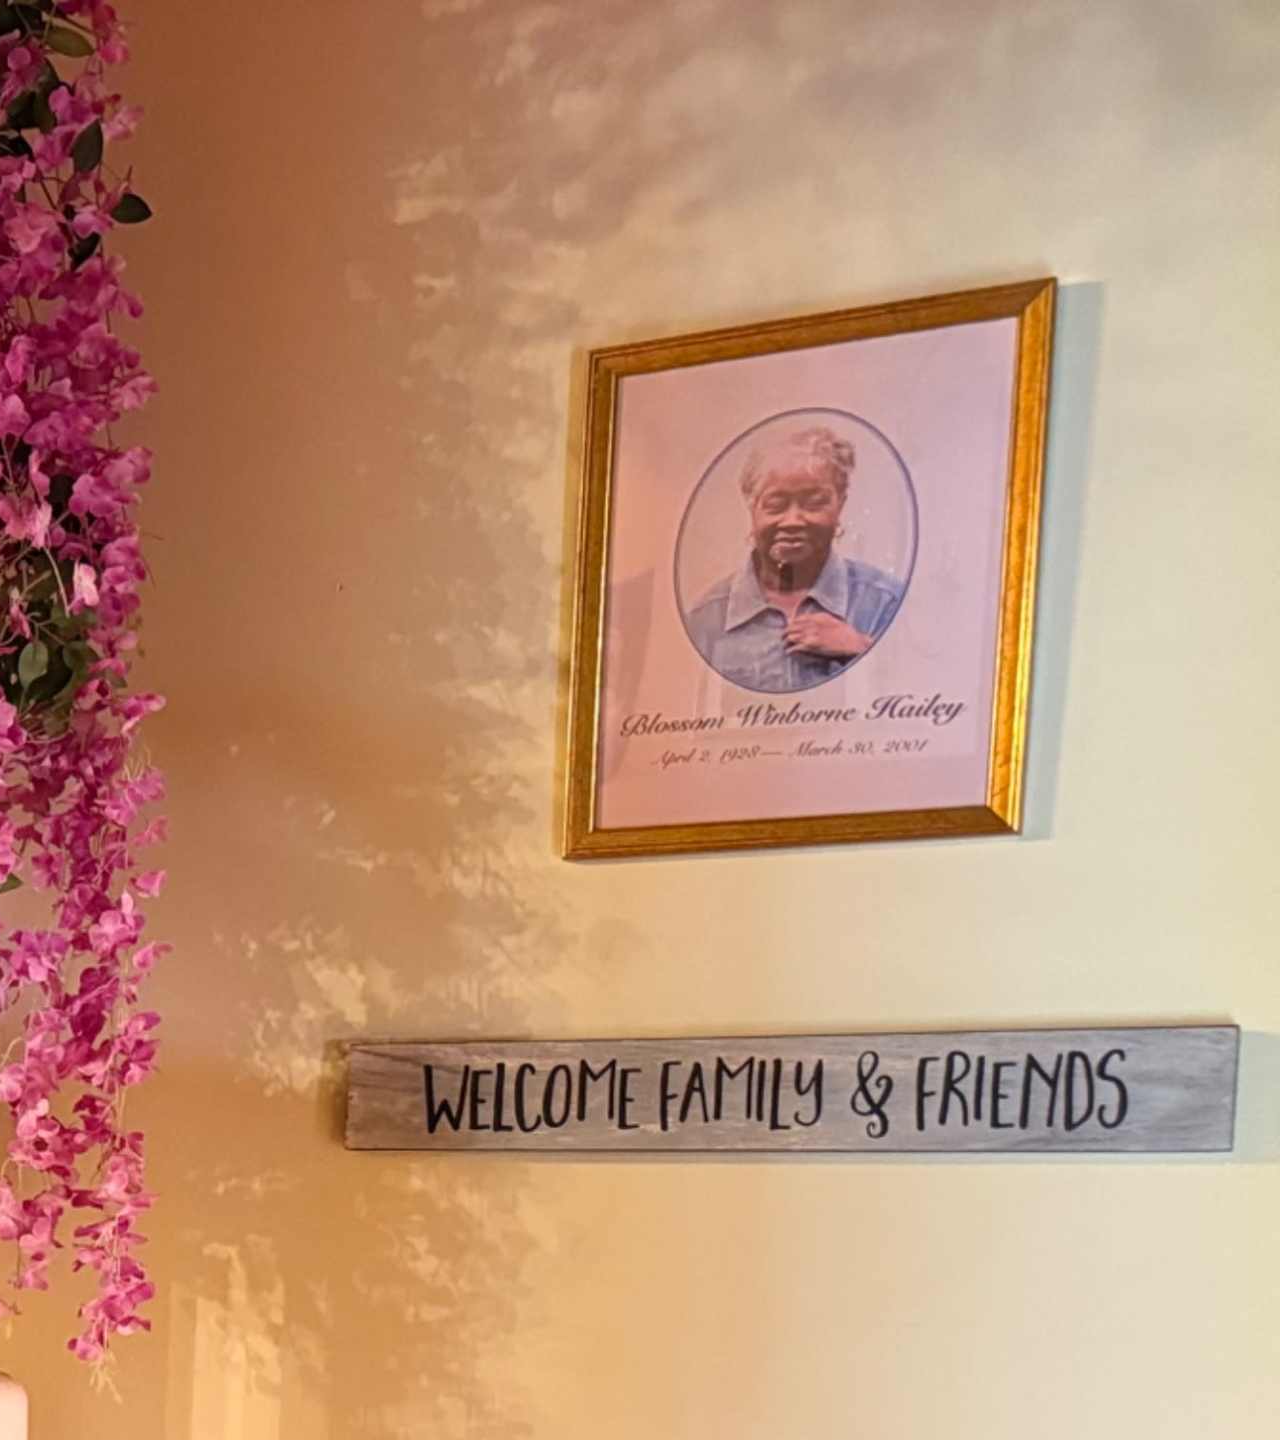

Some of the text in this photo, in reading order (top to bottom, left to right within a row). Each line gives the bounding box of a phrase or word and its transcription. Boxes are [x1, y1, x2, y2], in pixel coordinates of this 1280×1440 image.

[620, 693, 966, 737] Blossom Winborne Hailey
[650, 748, 697, 769] April
[789, 738, 844, 757] March
[423, 1048, 1128, 1138] WELCOME FAMILY & FRIENDS
